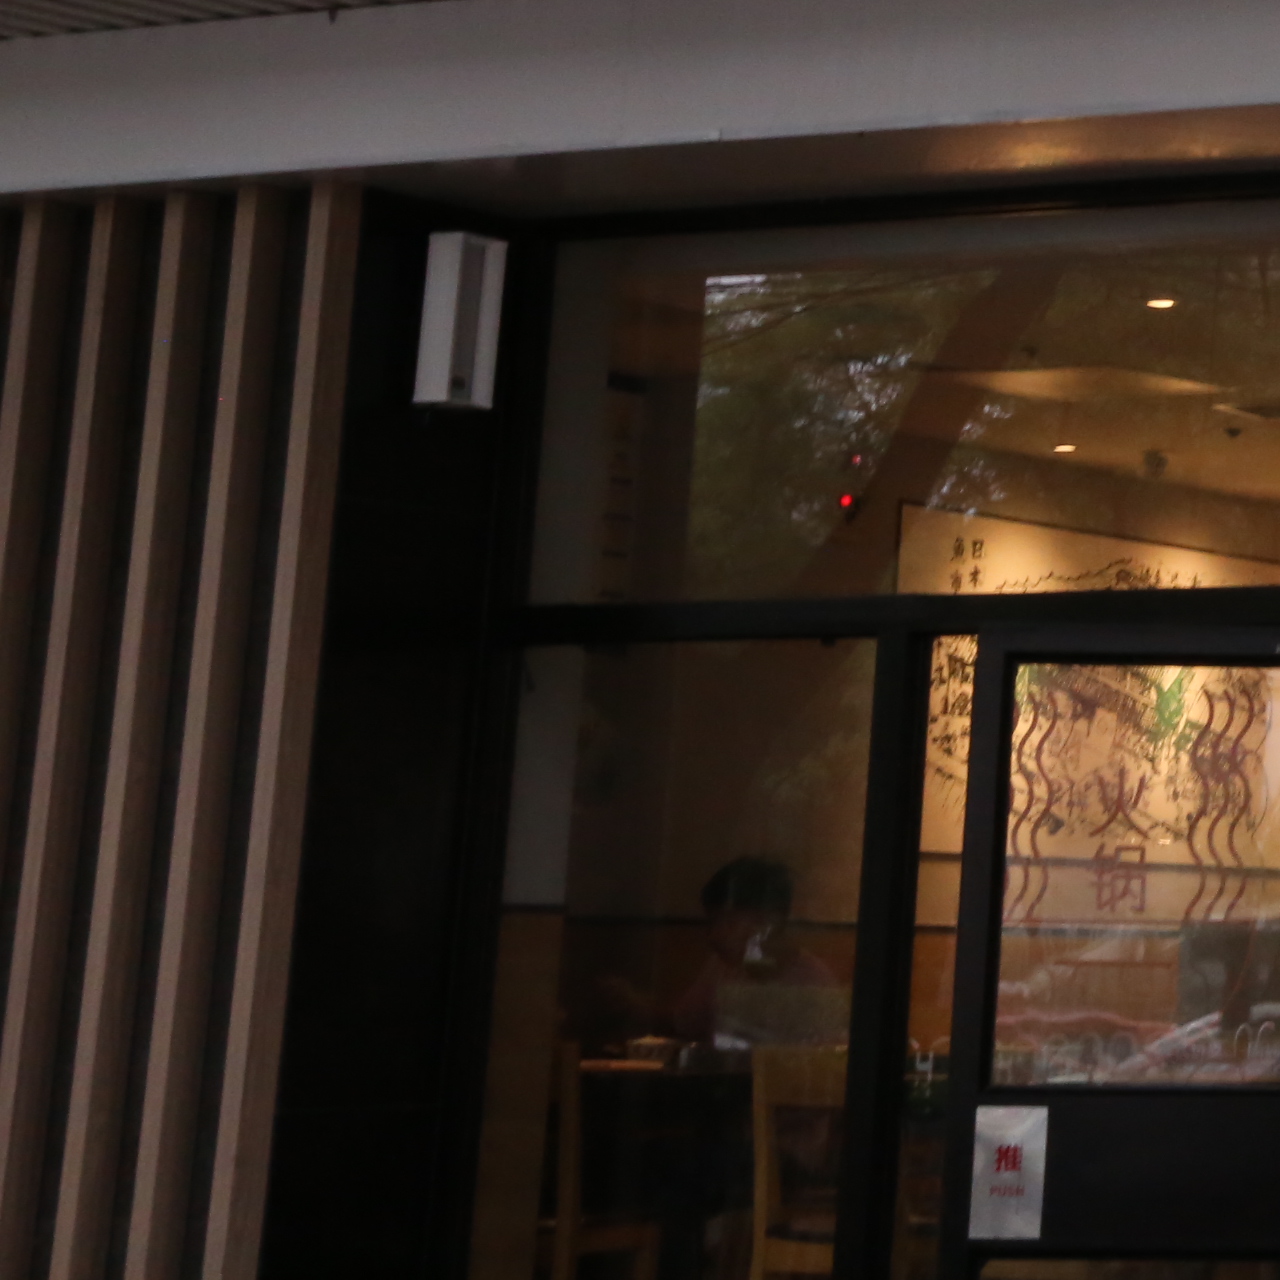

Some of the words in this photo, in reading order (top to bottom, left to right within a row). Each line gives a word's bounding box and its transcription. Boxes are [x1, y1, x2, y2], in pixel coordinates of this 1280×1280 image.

[1088, 766, 1150, 914] 火锅
[994, 1144, 1024, 1173] 推
[989, 1185, 1025, 1197] PUSH
